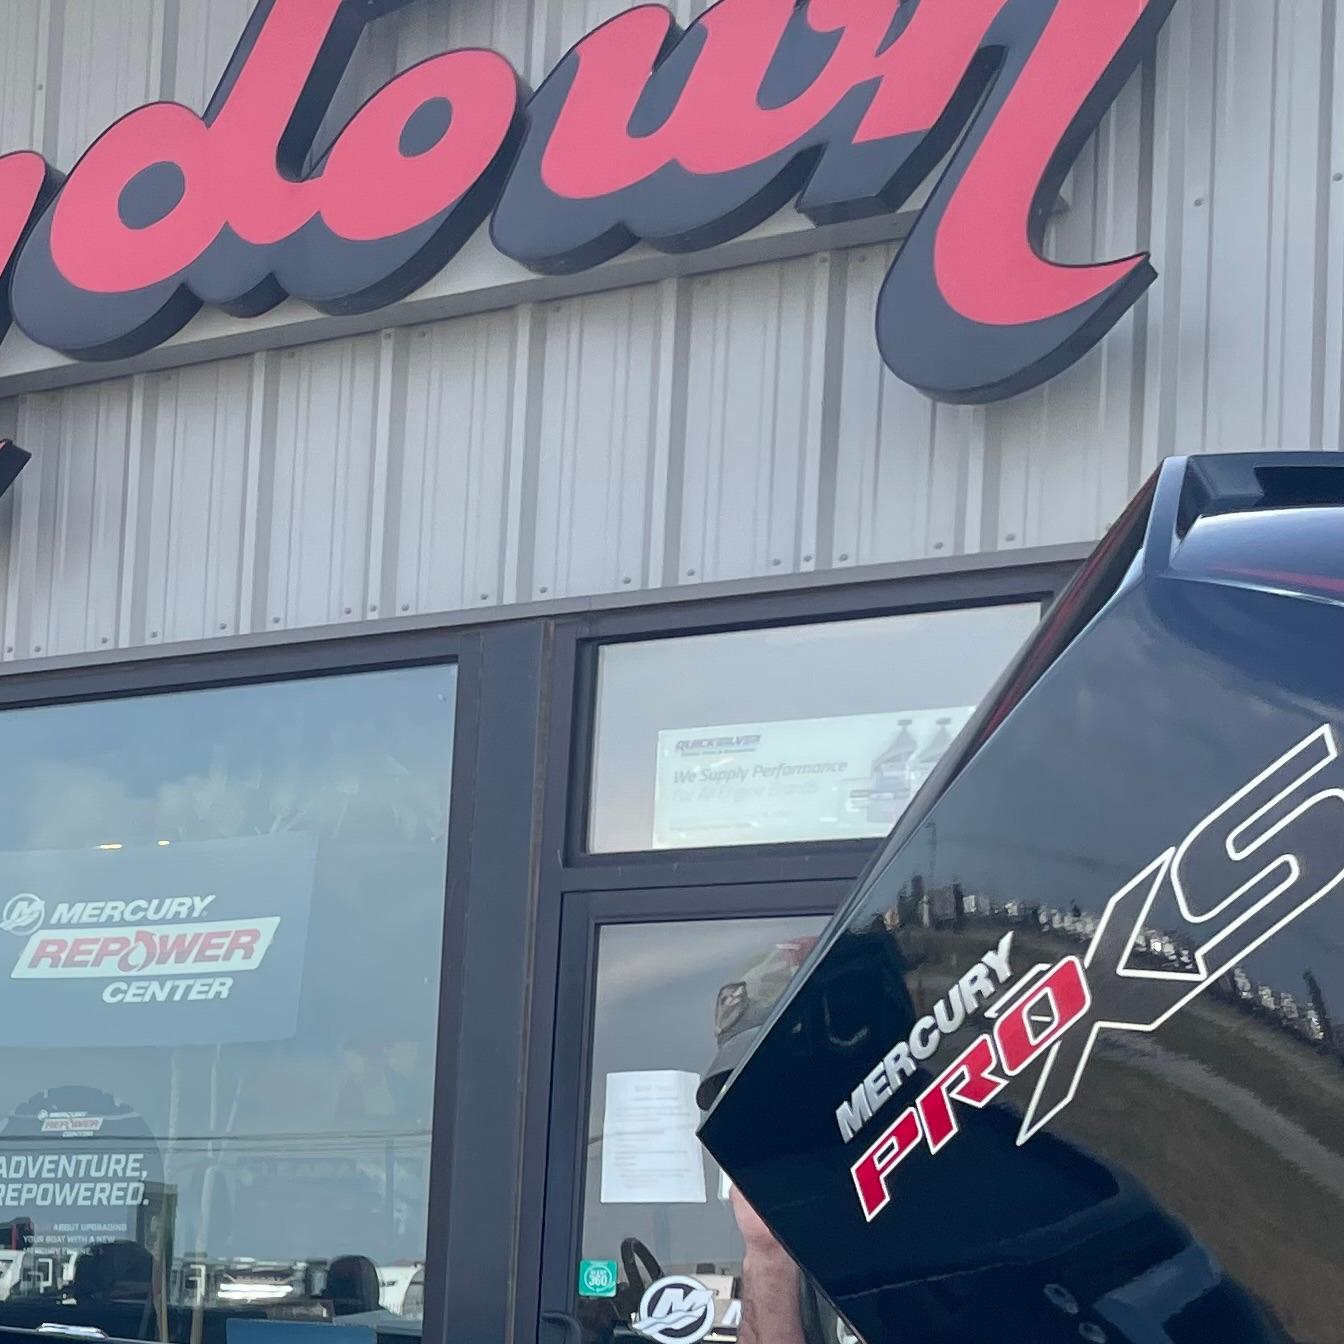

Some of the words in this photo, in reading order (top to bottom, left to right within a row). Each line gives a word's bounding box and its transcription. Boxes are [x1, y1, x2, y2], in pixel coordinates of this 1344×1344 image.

[698, 766, 749, 783] Supply
[752, 761, 848, 779] Performance
[50, 895, 216, 925] MERCURY
[27, 929, 261, 972] REPOWER
[102, 977, 233, 1003] CENTER
[836, 931, 1014, 1143] MERCURY
